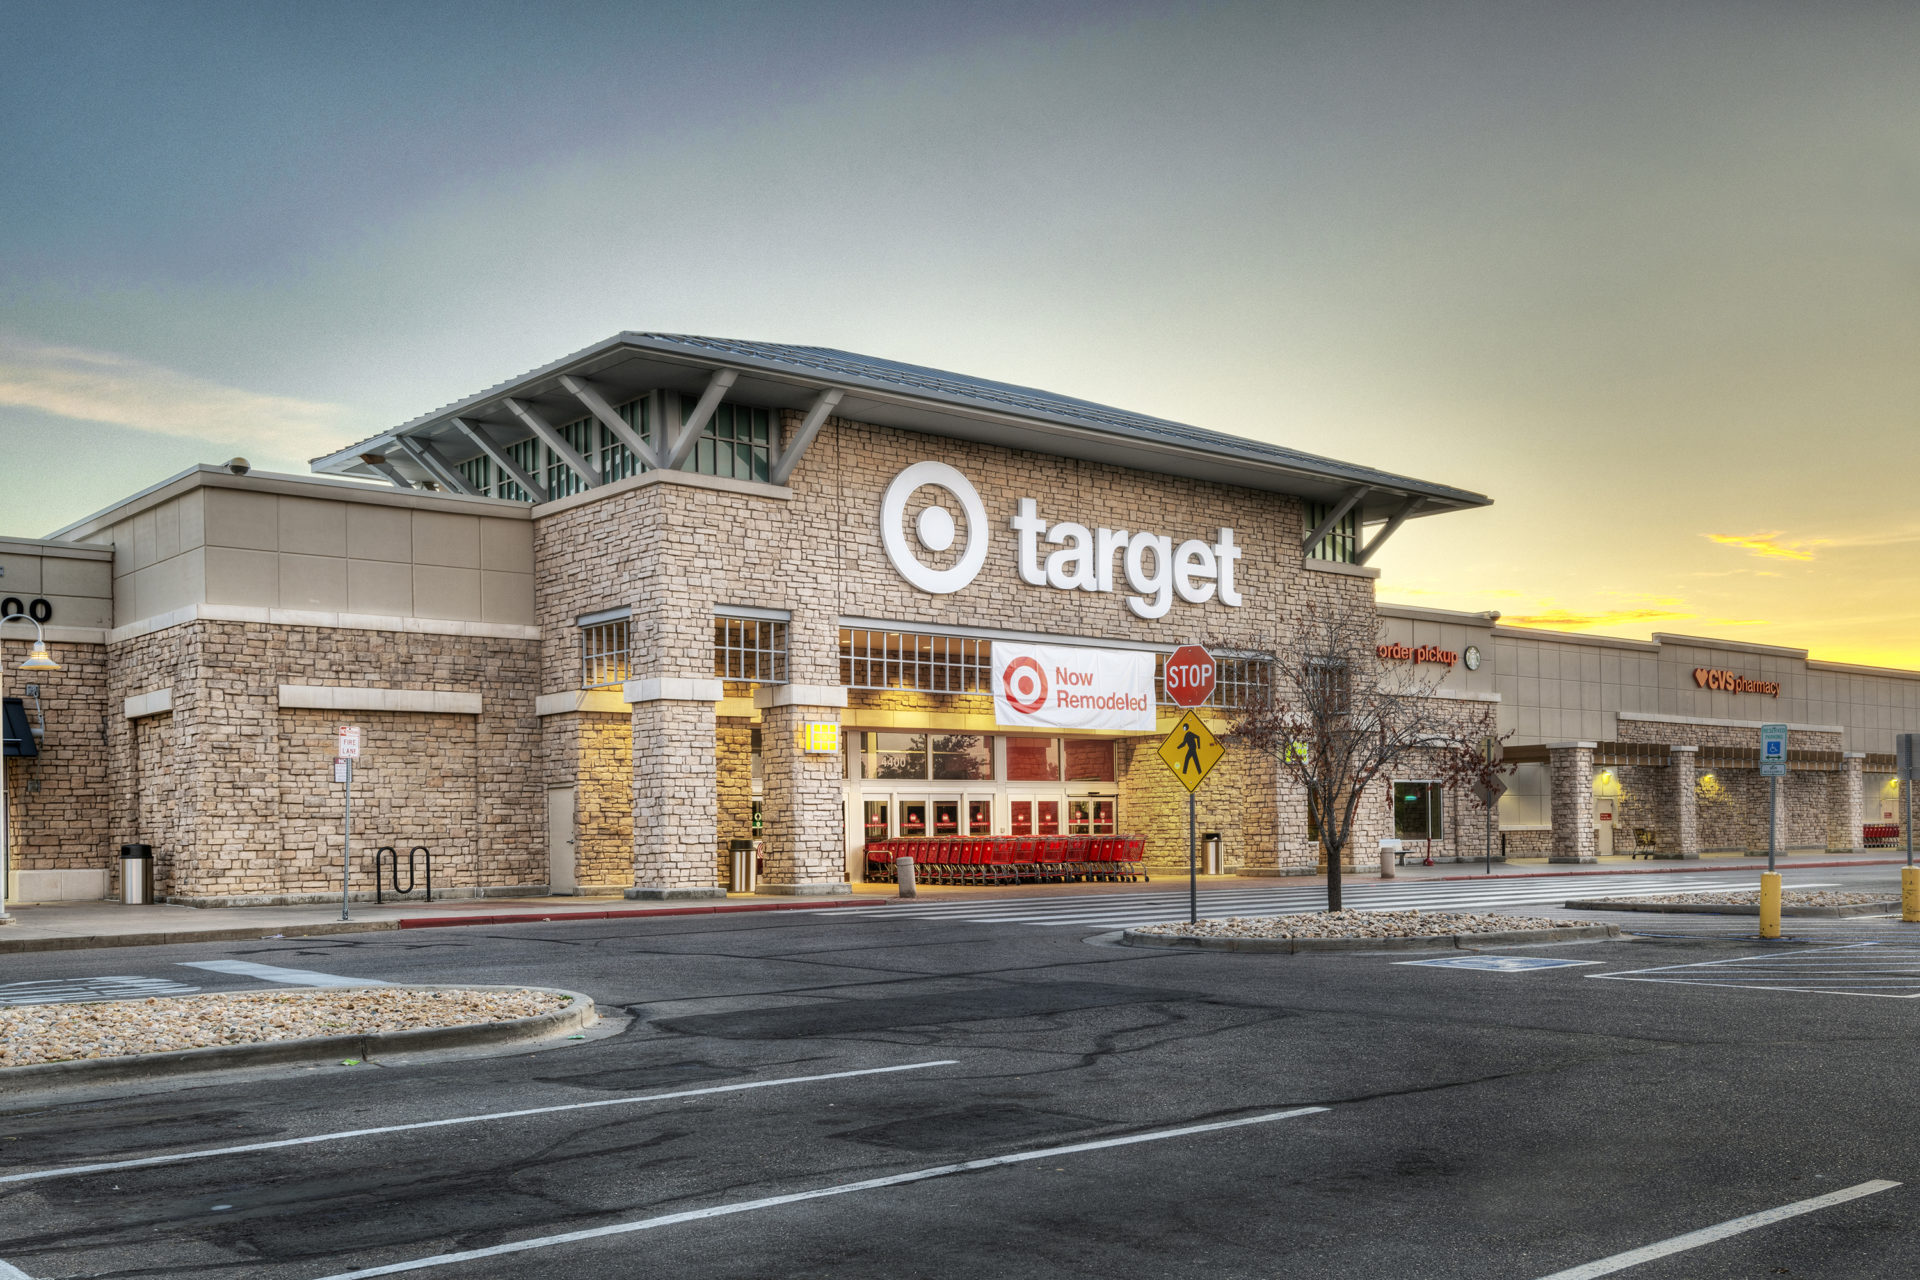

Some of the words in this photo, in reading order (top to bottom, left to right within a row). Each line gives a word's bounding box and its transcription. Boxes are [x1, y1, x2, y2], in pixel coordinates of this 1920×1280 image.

[1010, 498, 1242, 619] target
[1377, 642, 1415, 660] order
[1414, 645, 1459, 667] pickup
[1056, 667, 1093, 686] Now
[1169, 664, 1212, 689] STOP
[1708, 669, 1735, 691] CVS
[1733, 675, 1781, 699] pharmacy
[1056, 690, 1147, 711] Remodeled
[881, 757, 906, 767] 4400
